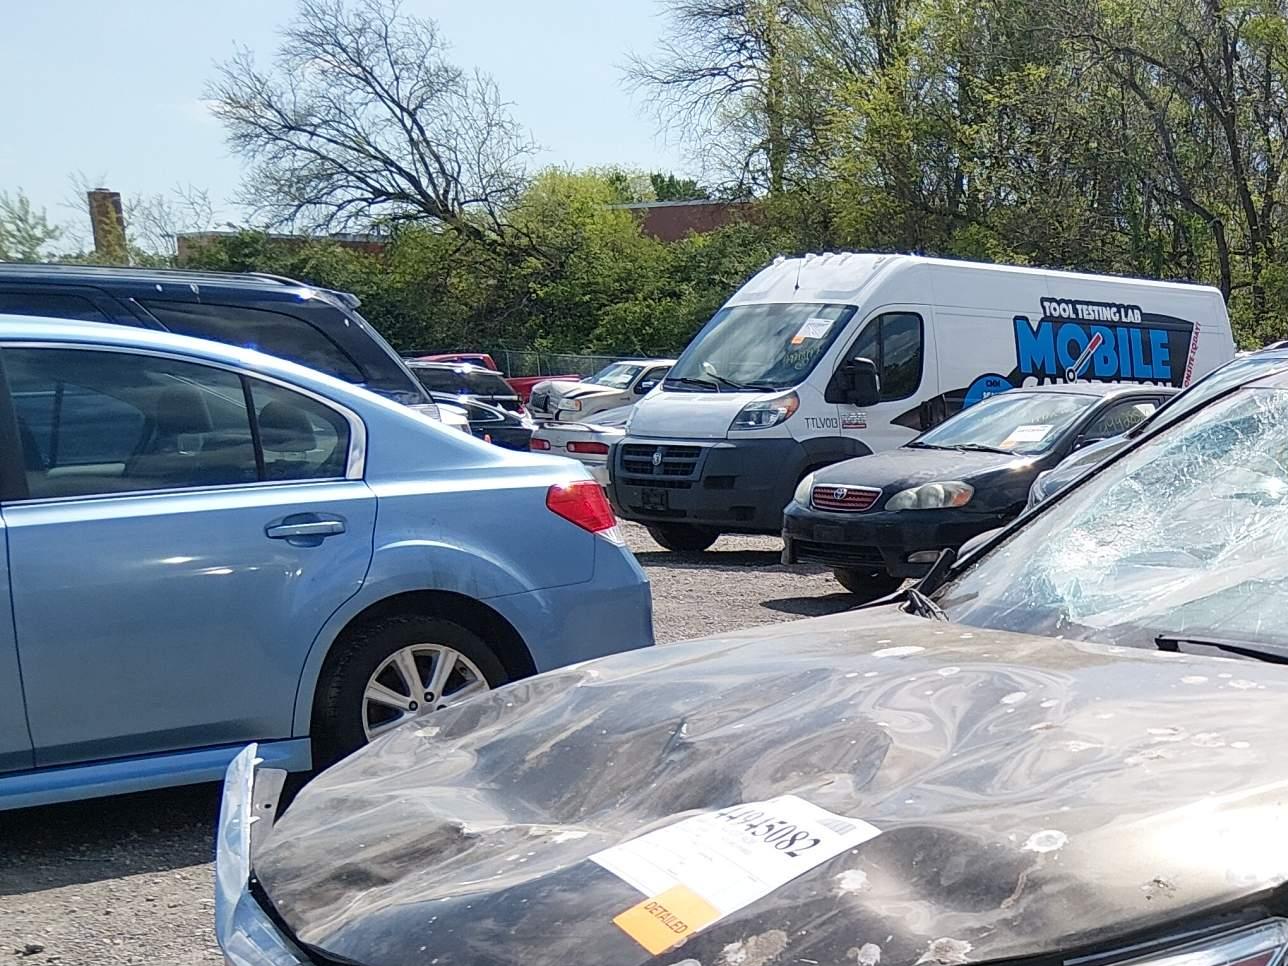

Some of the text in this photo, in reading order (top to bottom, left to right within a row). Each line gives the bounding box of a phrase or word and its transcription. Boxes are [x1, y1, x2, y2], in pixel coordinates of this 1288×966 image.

[1043, 301, 1142, 323] TOOL TESTING LAB
[1015, 319, 1172, 379] MOBILE
[804, 417, 838, 429] TTLV013
[644, 902, 688, 934] DETAILED
